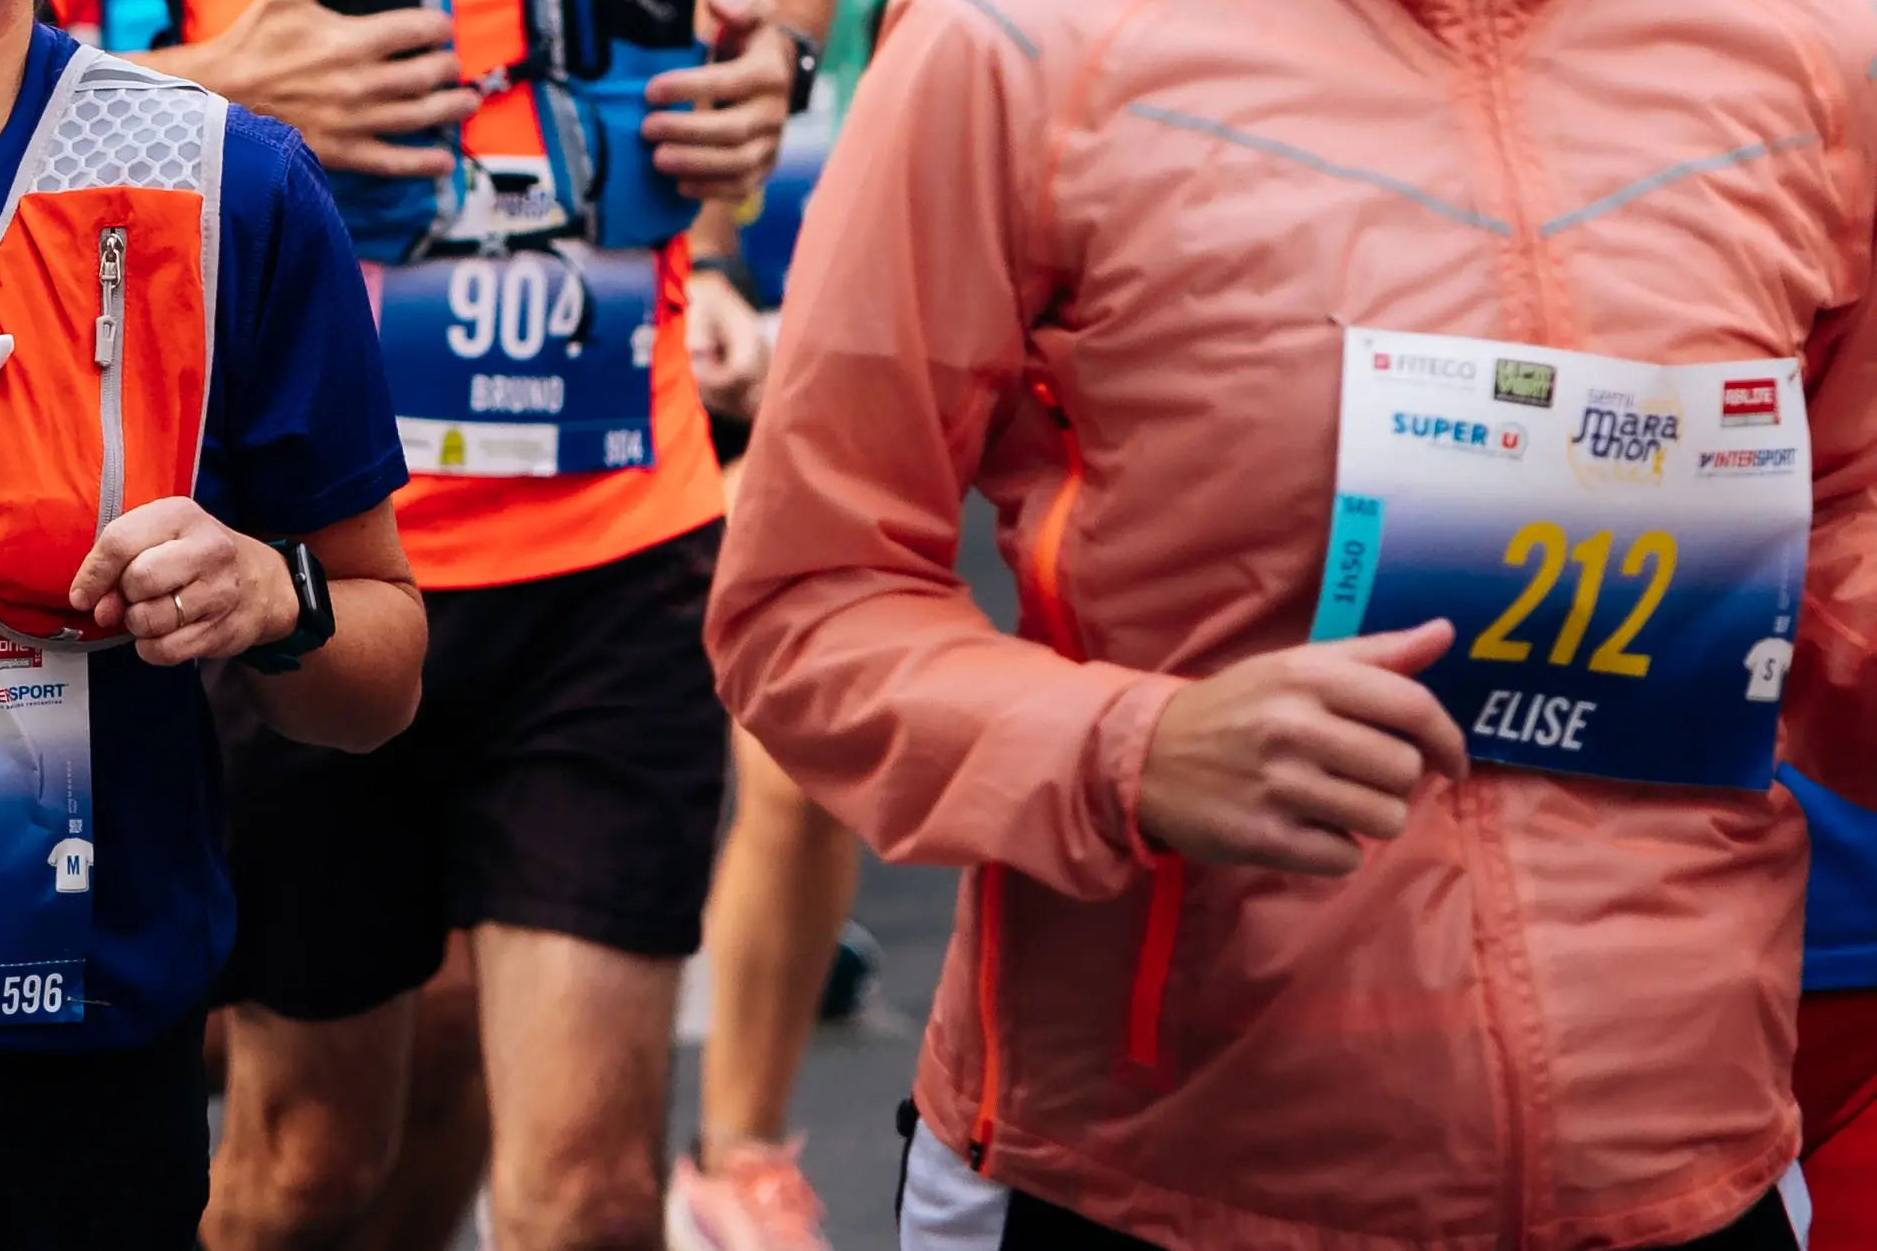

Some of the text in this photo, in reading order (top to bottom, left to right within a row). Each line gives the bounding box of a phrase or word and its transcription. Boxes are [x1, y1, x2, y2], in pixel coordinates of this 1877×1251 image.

[1391, 412, 1519, 450] SUPER U
[1714, 448, 1796, 468] INTERSPORT
[1334, 540, 1366, 604] 1h50
[1469, 520, 1678, 679] 212
[1762, 657, 1776, 681] S
[1473, 690, 1596, 750] ELISE
[66, 855, 80, 875] M
[2, 973, 63, 1015] 596
